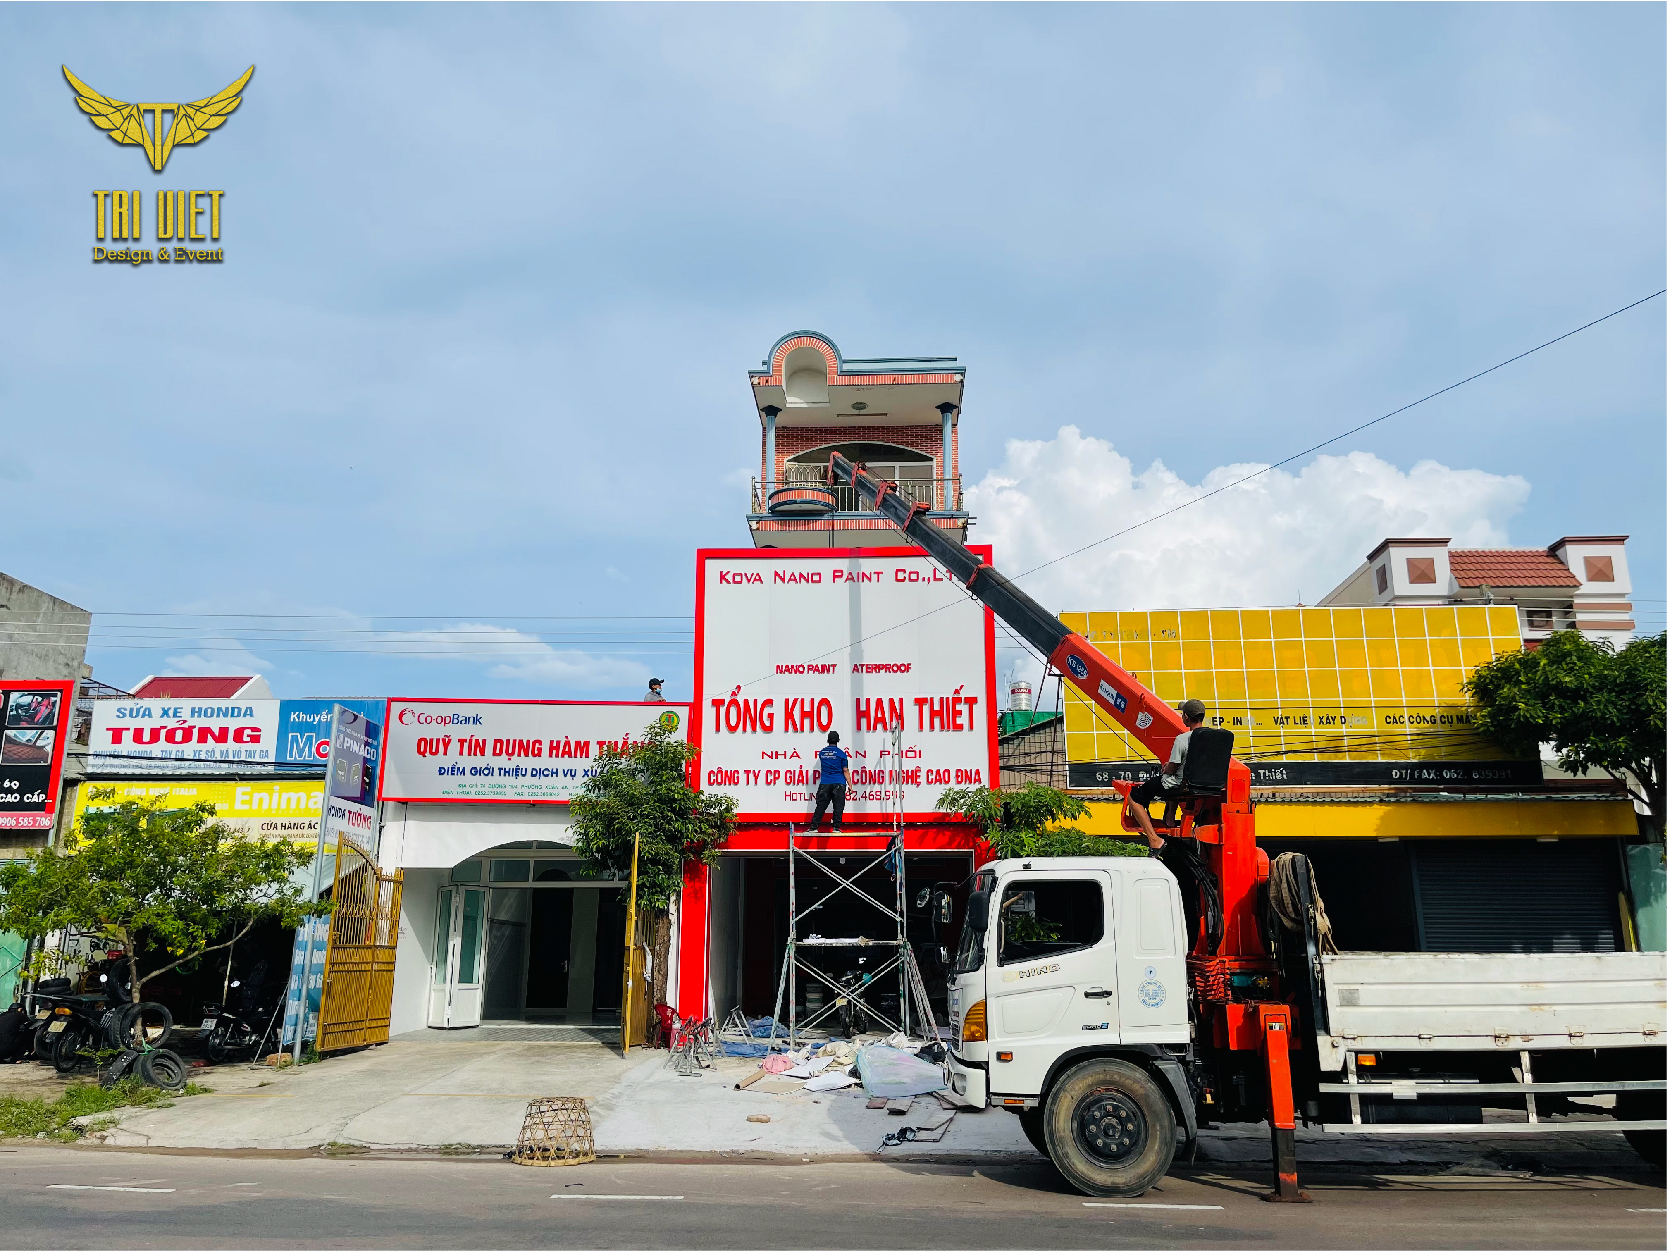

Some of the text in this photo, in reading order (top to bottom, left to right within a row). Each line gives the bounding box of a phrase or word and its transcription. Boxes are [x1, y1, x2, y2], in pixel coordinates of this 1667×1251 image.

[775, 664, 805, 674] NANO
[807, 664, 837, 674] PAINT
[115, 702, 254, 719] SỬA XE HONDA
[711, 684, 774, 733] TỔNG
[784, 697, 833, 732] KHO
[914, 684, 978, 732] THIẾT
[417, 712, 483, 727] Co-opBank
[1273, 714, 1291, 728] VẬT
[1318, 713, 1337, 726] XÂY
[1384, 713, 1405, 726] CÁC
[1408, 712, 1437, 725] CÔNG
[1439, 714, 1454, 727] CỤ
[106, 719, 262, 745] TƯỞNG
[193, 749, 203, 759] XE
[220, 748, 229, 760] VÁ
[245, 750, 257, 760] TAY
[259, 750, 269, 760] GA
[343, 736, 377, 761] PINACO
[416, 734, 452, 758] QUỸ
[457, 734, 487, 757] TÍN
[492, 739, 543, 761] DỤNG
[549, 735, 590, 758] HÀM
[761, 749, 801, 760] NHÀ
[814, 746, 867, 759] PÂN
[438, 761, 466, 776] ĐIỂM
[469, 763, 494, 777] GIỚI
[498, 765, 527, 779] THIỆU
[531, 767, 558, 779] DỊCH
[562, 768, 577, 779] VỤ
[707, 766, 739, 786] CÔNG
[744, 769, 761, 785] TY
[765, 769, 780, 785] CP
[784, 764, 809, 785] GIẢI
[851, 765, 885, 785] CÔNG
[926, 768, 951, 785] CAO
[955, 768, 981, 785] ĐNA
[1095, 772, 1109, 782] 68
[1259, 768, 1287, 781] Thiết
[172, 787, 197, 796] ITALIA
[18, 816, 33, 827] 585
[35, 816, 51, 827] 706
[261, 820, 278, 831] CỬA
[281, 820, 305, 831] HÀNG
